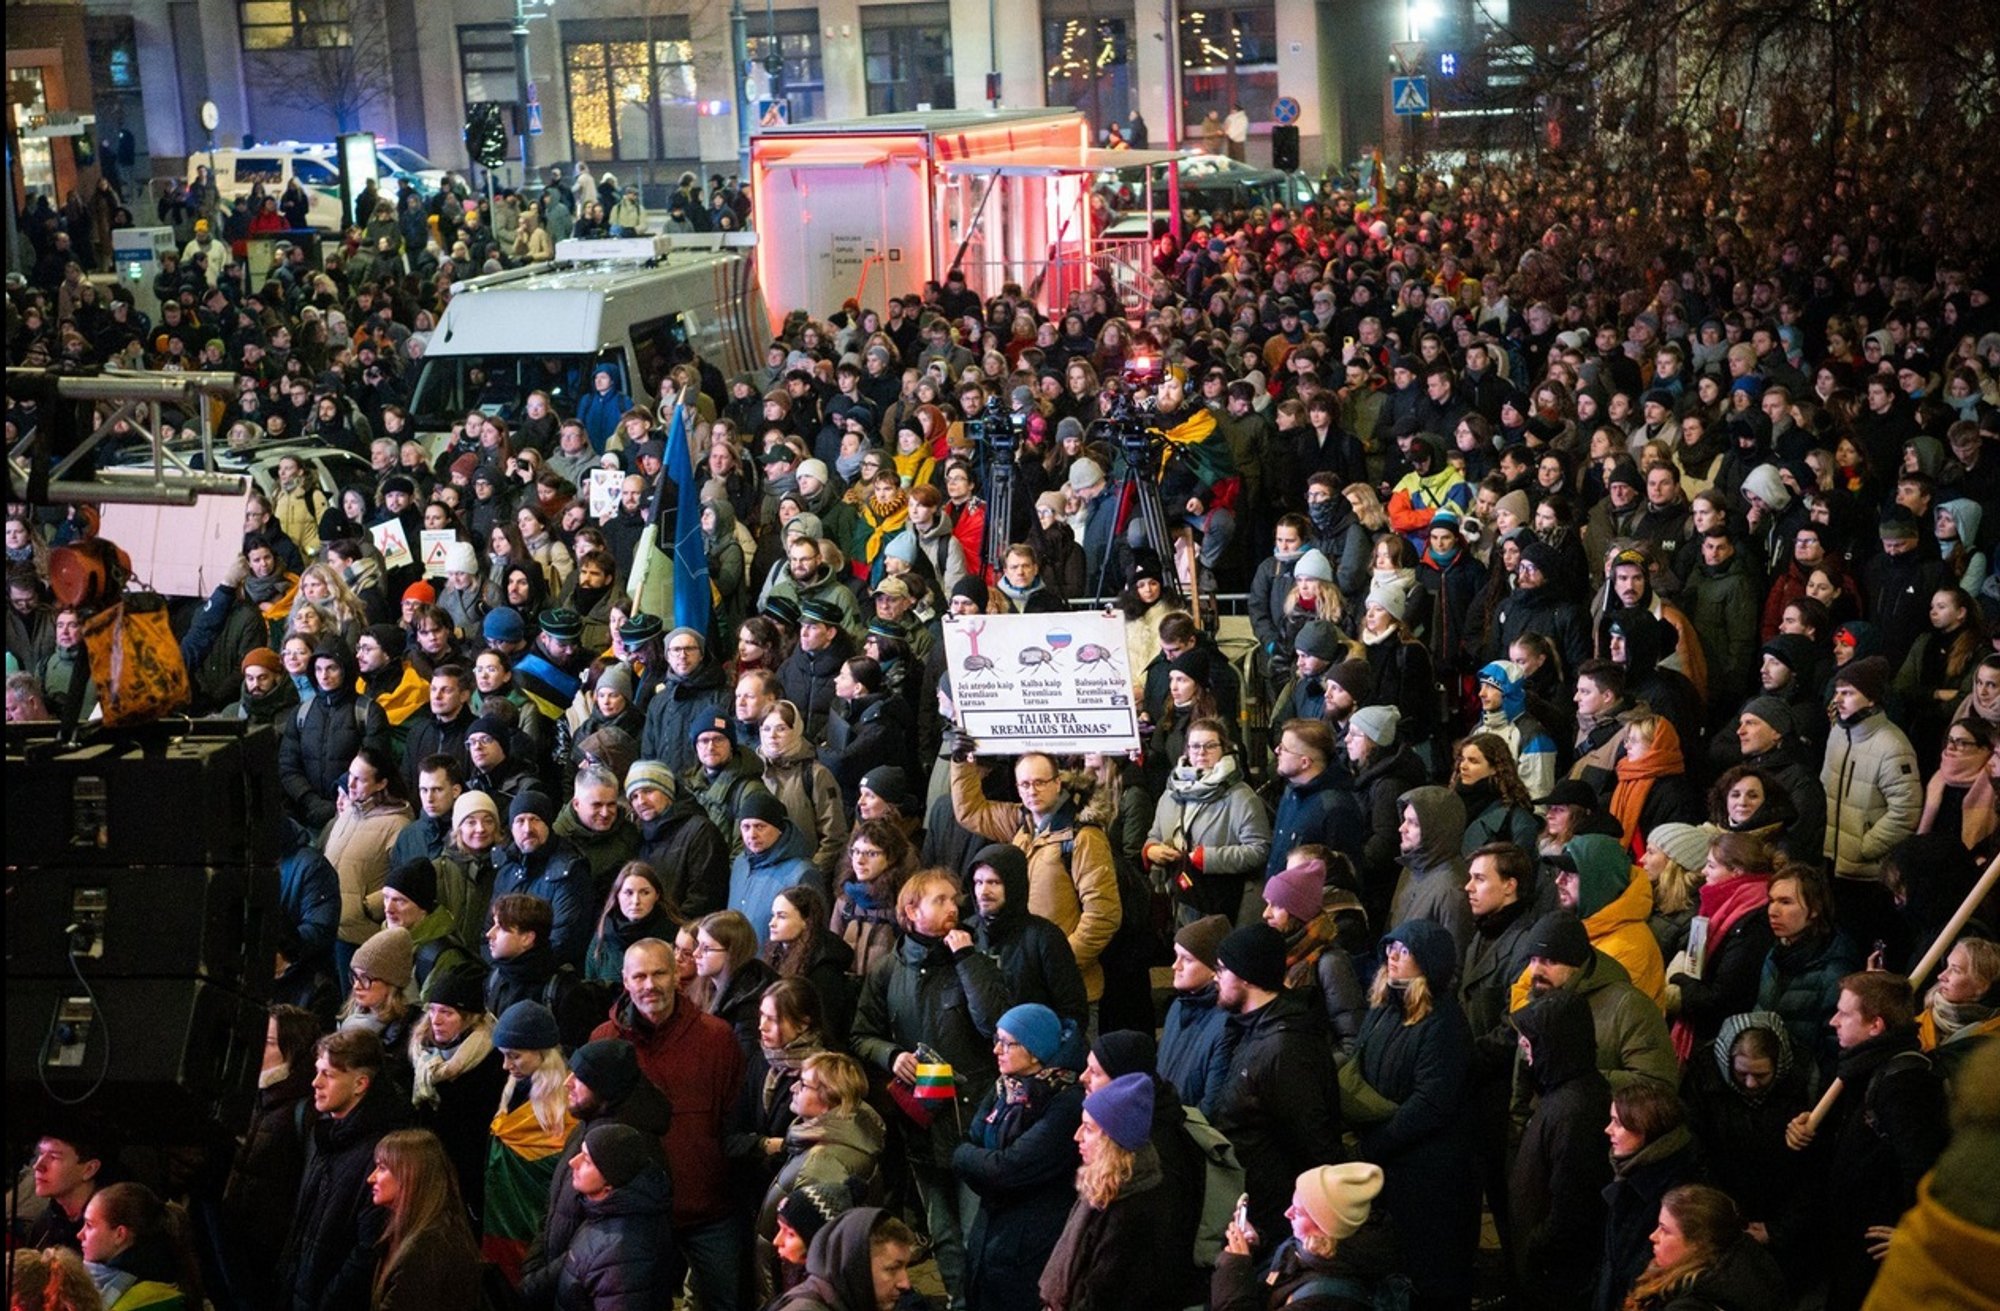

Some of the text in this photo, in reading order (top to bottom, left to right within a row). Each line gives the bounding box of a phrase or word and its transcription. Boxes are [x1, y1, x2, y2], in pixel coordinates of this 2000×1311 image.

[958, 681, 1014, 691] Jei atrodo kaip
[1020, 678, 1062, 688] Kalba kaip
[1074, 677, 1126, 688] Balsuoja kaip
[958, 690, 999, 698] Kremliaus
[1022, 688, 1062, 696] Kremliaus
[1075, 688, 1117, 696] Kremliaus
[1023, 697, 1049, 705] tarnas
[1017, 712, 1077, 724] TAI IR YRA
[990, 724, 1058, 735] KREMLIAUS
